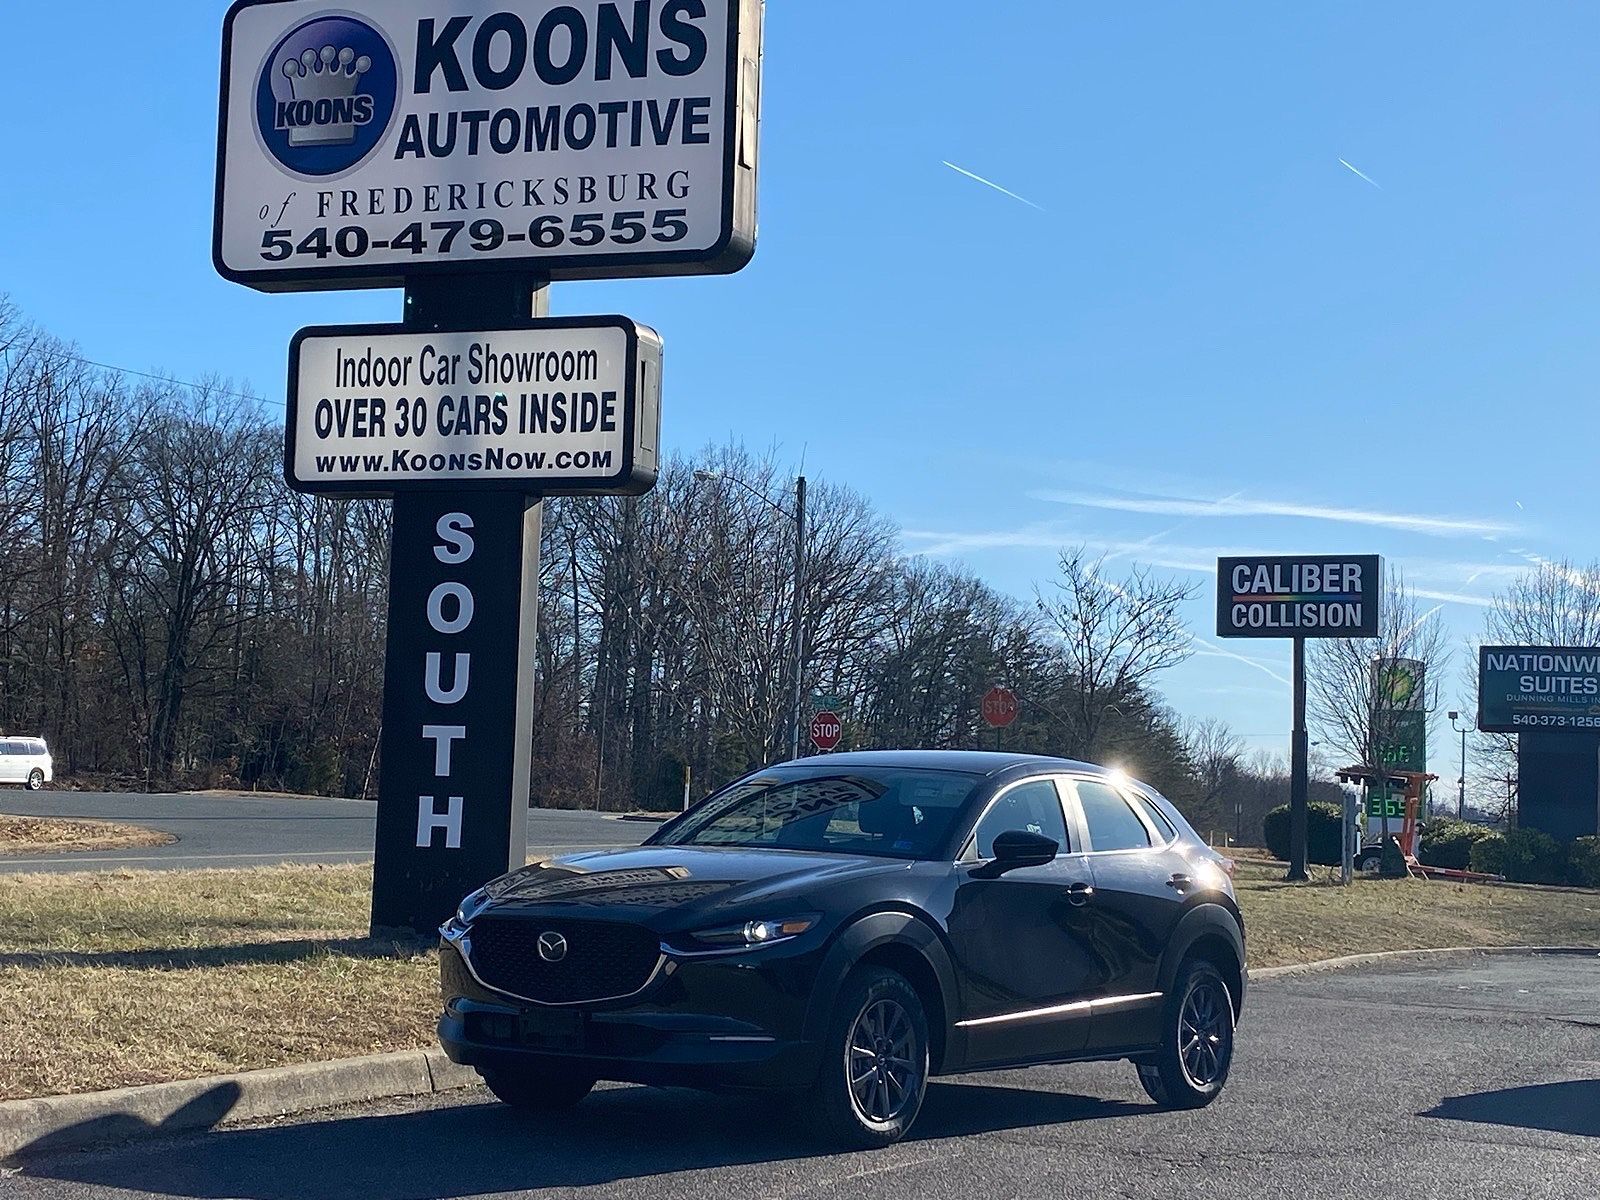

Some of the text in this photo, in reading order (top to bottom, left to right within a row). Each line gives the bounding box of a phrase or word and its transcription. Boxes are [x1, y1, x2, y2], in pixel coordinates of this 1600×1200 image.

[414, 0, 707, 94] KOONS
[276, 95, 374, 129] KOONS
[394, 97, 711, 160] AUTOMOTIVE
[258, 170, 691, 229] of FREDERICKSBURG
[259, 208, 689, 262] 540-479-6555
[335, 342, 598, 388] Indoor Car Showroom
[314, 391, 618, 439] OVER 30 CARS INSIDE
[1231, 563, 1363, 594] CALIBER
[1231, 602, 1362, 628] COLLISION
[415, 512, 475, 849] SOUTH
[1505, 694, 1554, 703] DUNNING
[1557, 695, 1588, 704] MILLS
[1519, 675, 1598, 695] SUITES
[812, 723, 840, 738] STOP
[1512, 714, 1600, 728] 540-373-1256
